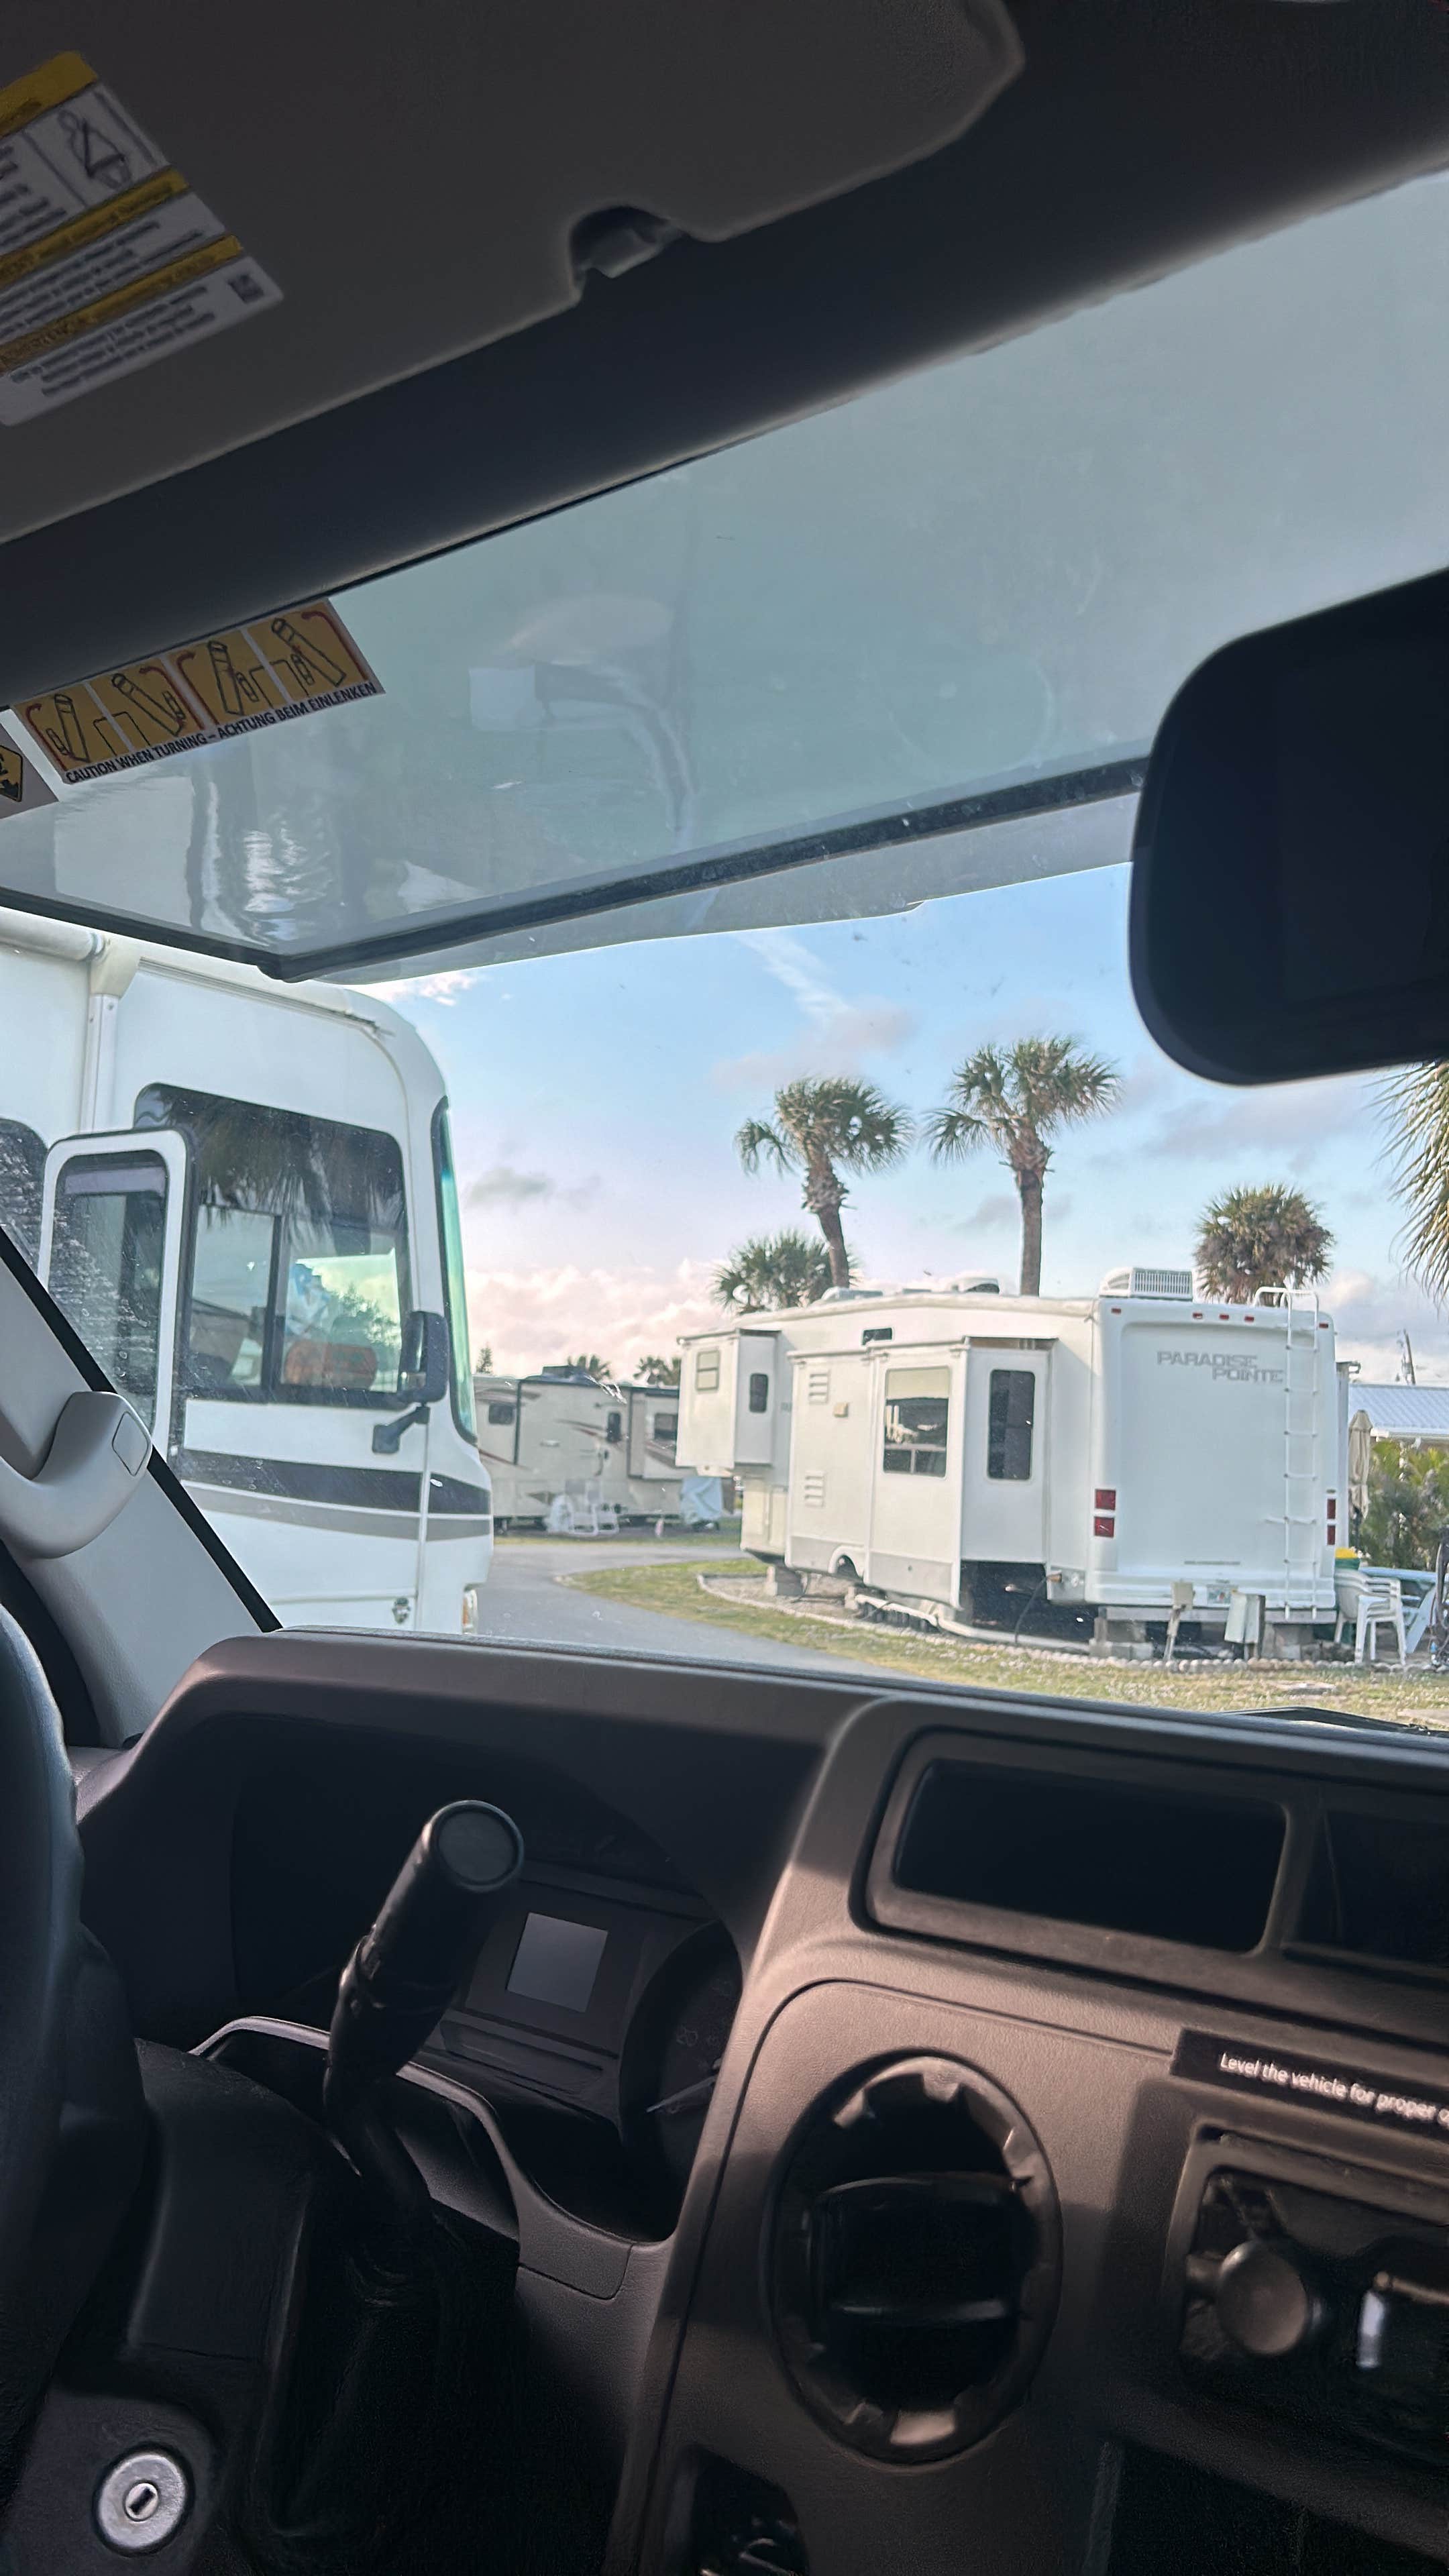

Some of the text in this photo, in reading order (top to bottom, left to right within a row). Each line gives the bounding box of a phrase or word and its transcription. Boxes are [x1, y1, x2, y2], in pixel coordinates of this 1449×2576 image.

[66, 760, 117, 783] CAUTION
[116, 749, 154, 769] WHEN
[151, 733, 207, 757] TURNING
[217, 712, 276, 739] ACHTUNG
[275, 702, 309, 722] BEIM
[308, 682, 377, 711] EINLENKEN
[1157, 1351, 1258, 1368] PARADISE
[1212, 1367, 1284, 1383] POINTE
[1220, 2052, 1260, 2078] Level
[1262, 2063, 1289, 2084] the
[1291, 2072, 1348, 2100] vehicle
[1350, 2083, 1375, 2105] for
[1375, 2094, 1436, 2120] proper
